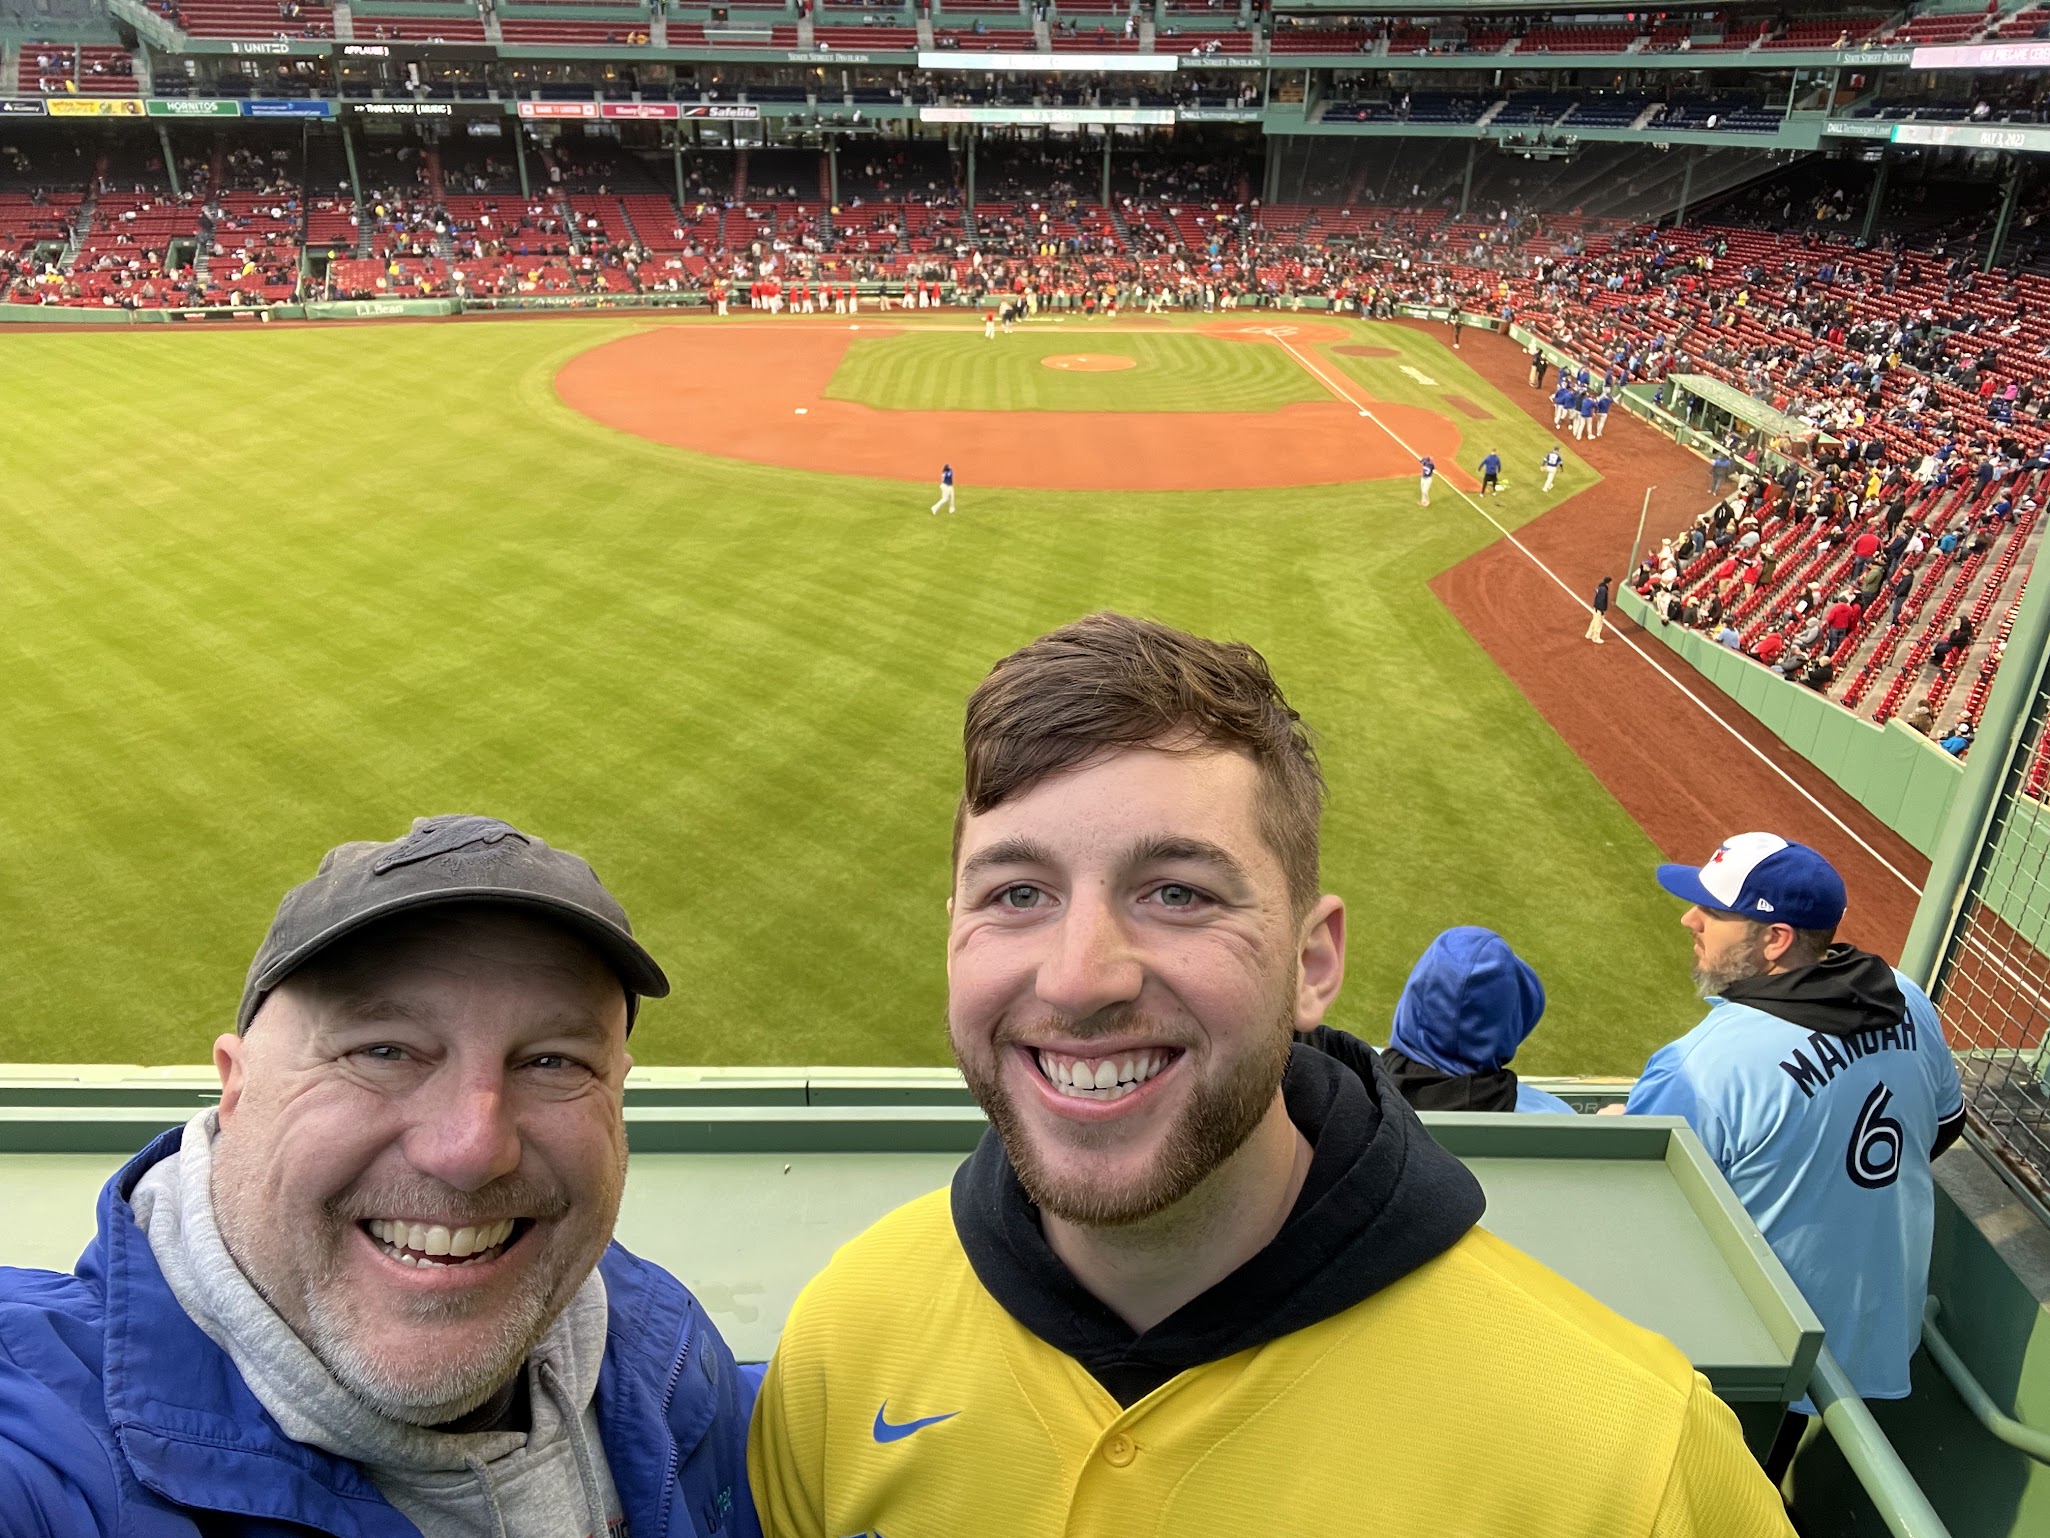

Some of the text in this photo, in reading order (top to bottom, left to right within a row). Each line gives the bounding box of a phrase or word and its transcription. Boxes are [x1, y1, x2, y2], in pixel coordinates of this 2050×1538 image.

[244, 43, 289, 53] UNITED
[166, 101, 219, 110] HORNITOS
[709, 106, 757, 118] Safelite
[1779, 1006, 1917, 1099] MANOAH
[1846, 1081, 1903, 1189] 6
